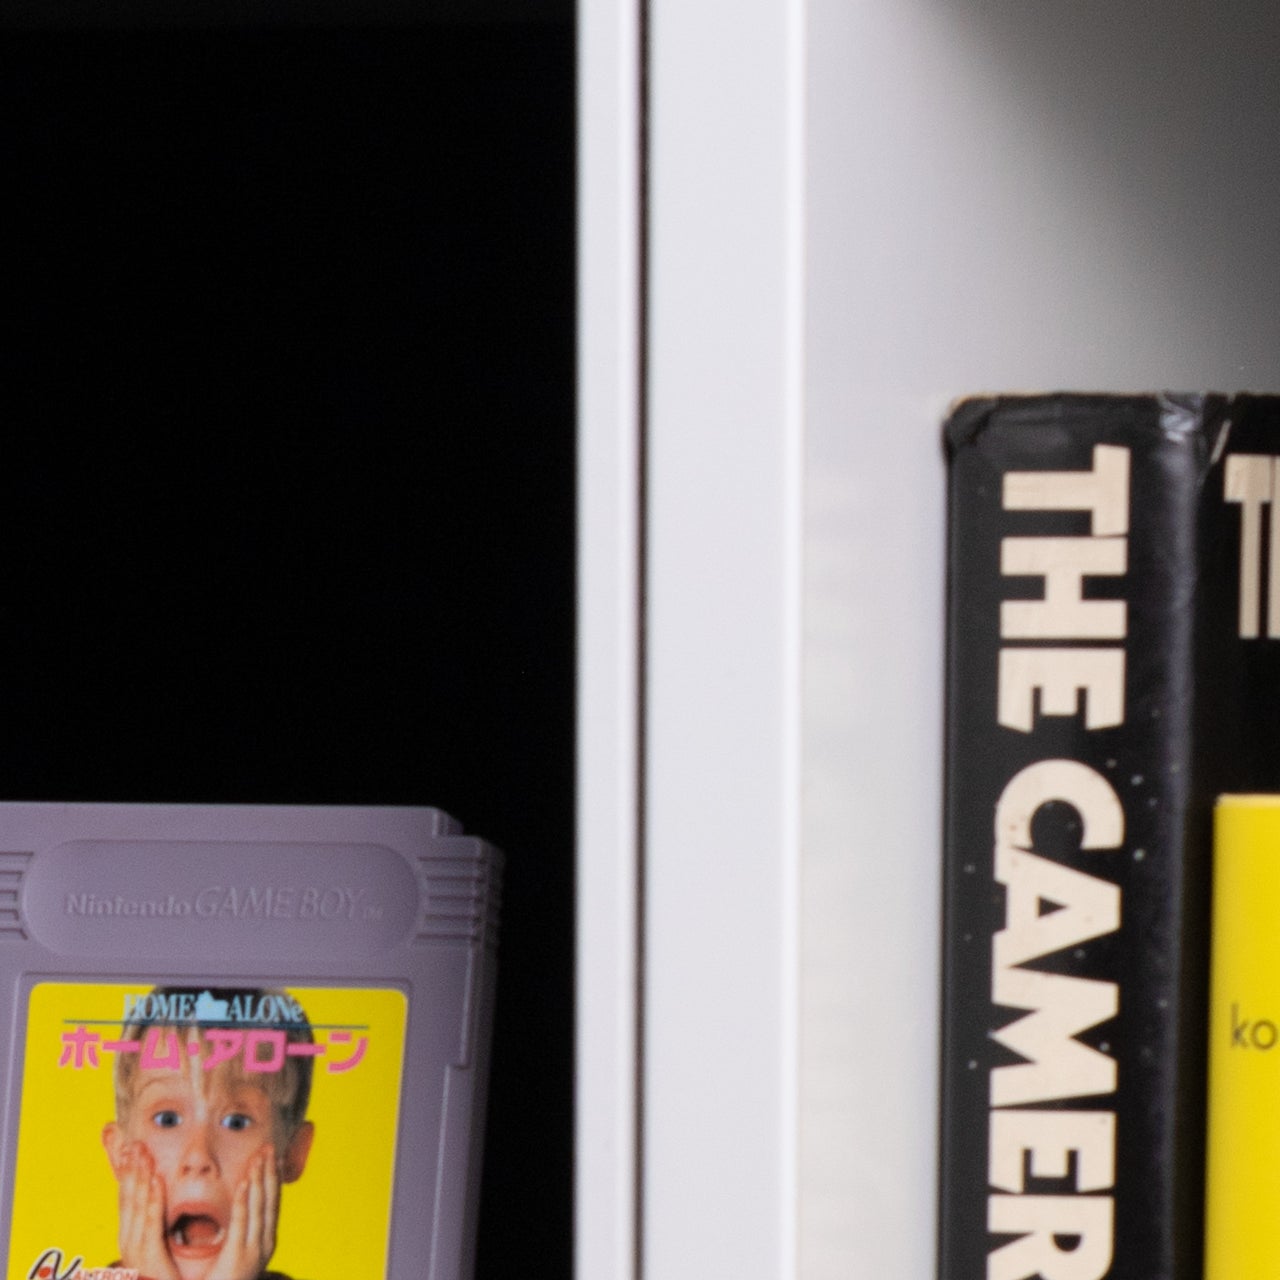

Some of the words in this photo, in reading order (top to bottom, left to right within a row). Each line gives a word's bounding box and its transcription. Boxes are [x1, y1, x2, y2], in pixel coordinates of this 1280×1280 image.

[997, 443, 1132, 734] THE
[64, 891, 194, 919] Nintendo
[195, 885, 296, 919] GAME
[298, 886, 364, 920] BOY
[123, 994, 196, 1021] HOME
[58, 1026, 370, 1074] ホーム・アローン
